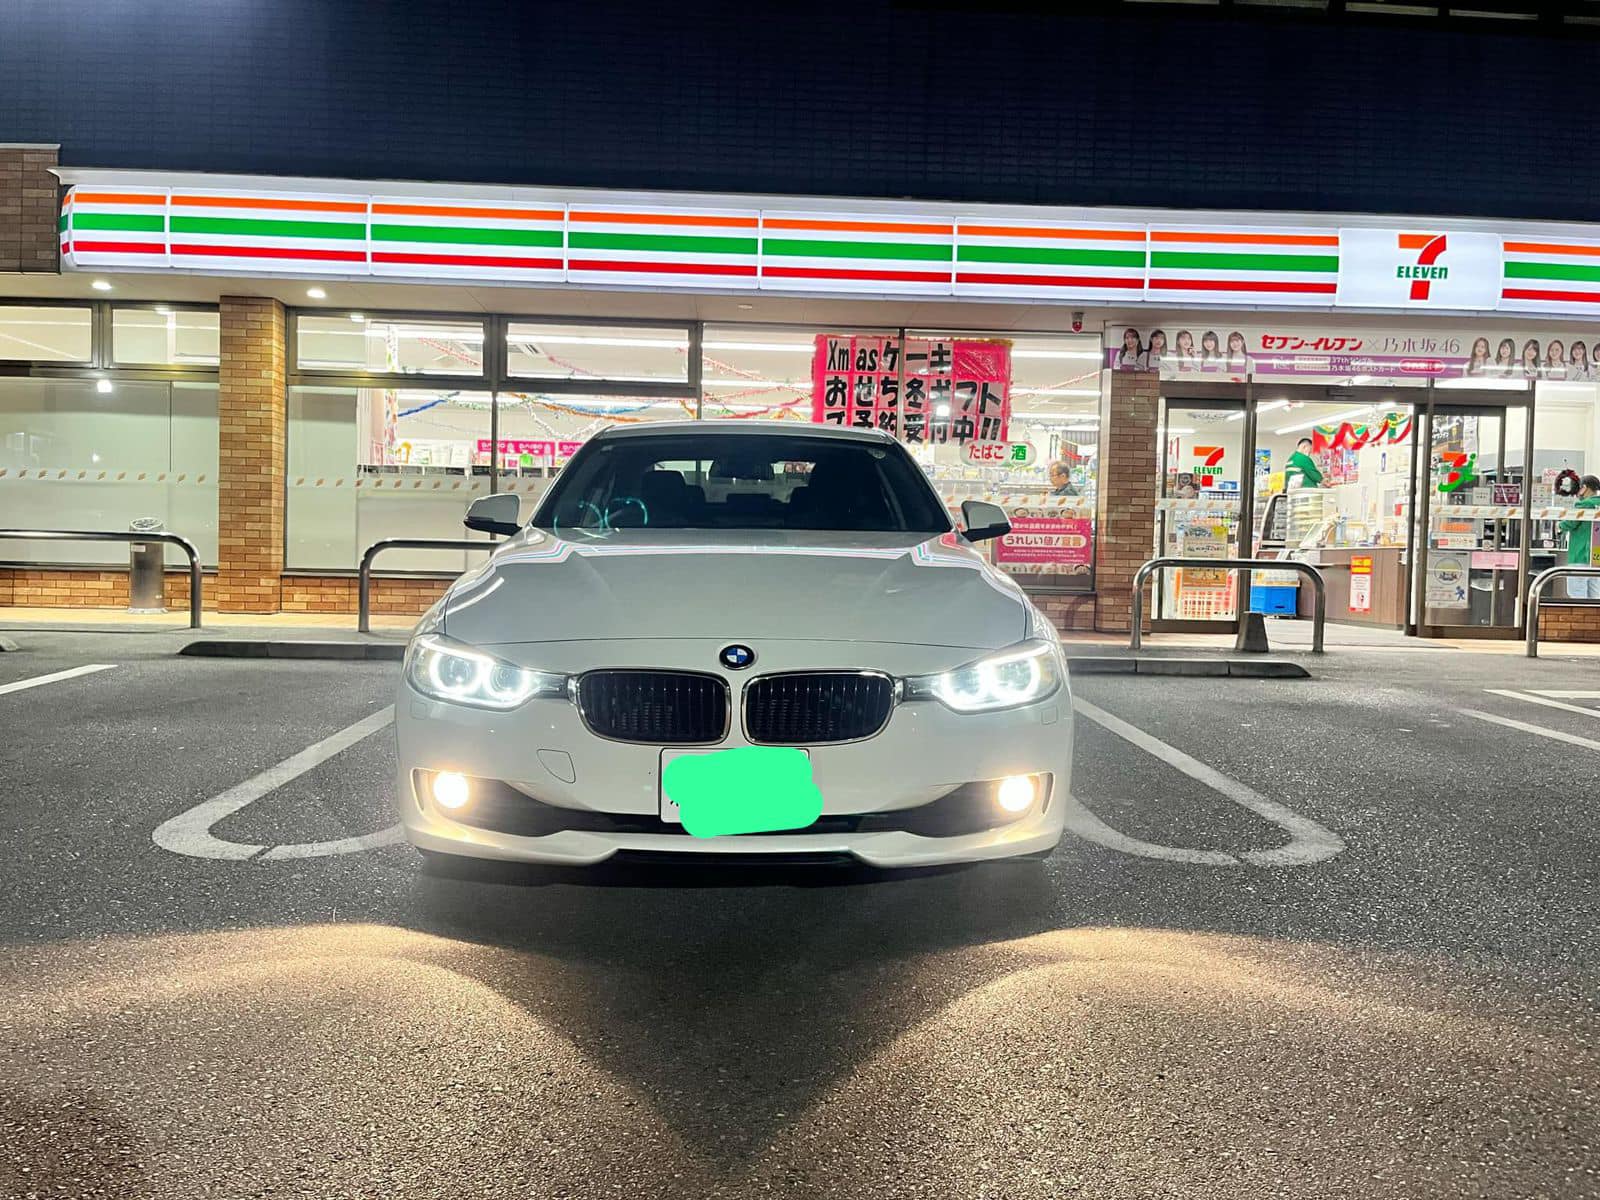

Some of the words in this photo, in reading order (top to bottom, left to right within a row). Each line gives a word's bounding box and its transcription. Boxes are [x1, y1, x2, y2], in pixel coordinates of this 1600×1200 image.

[969, 444, 1004, 459] たばこ
[1011, 445, 1027, 460] 酒
